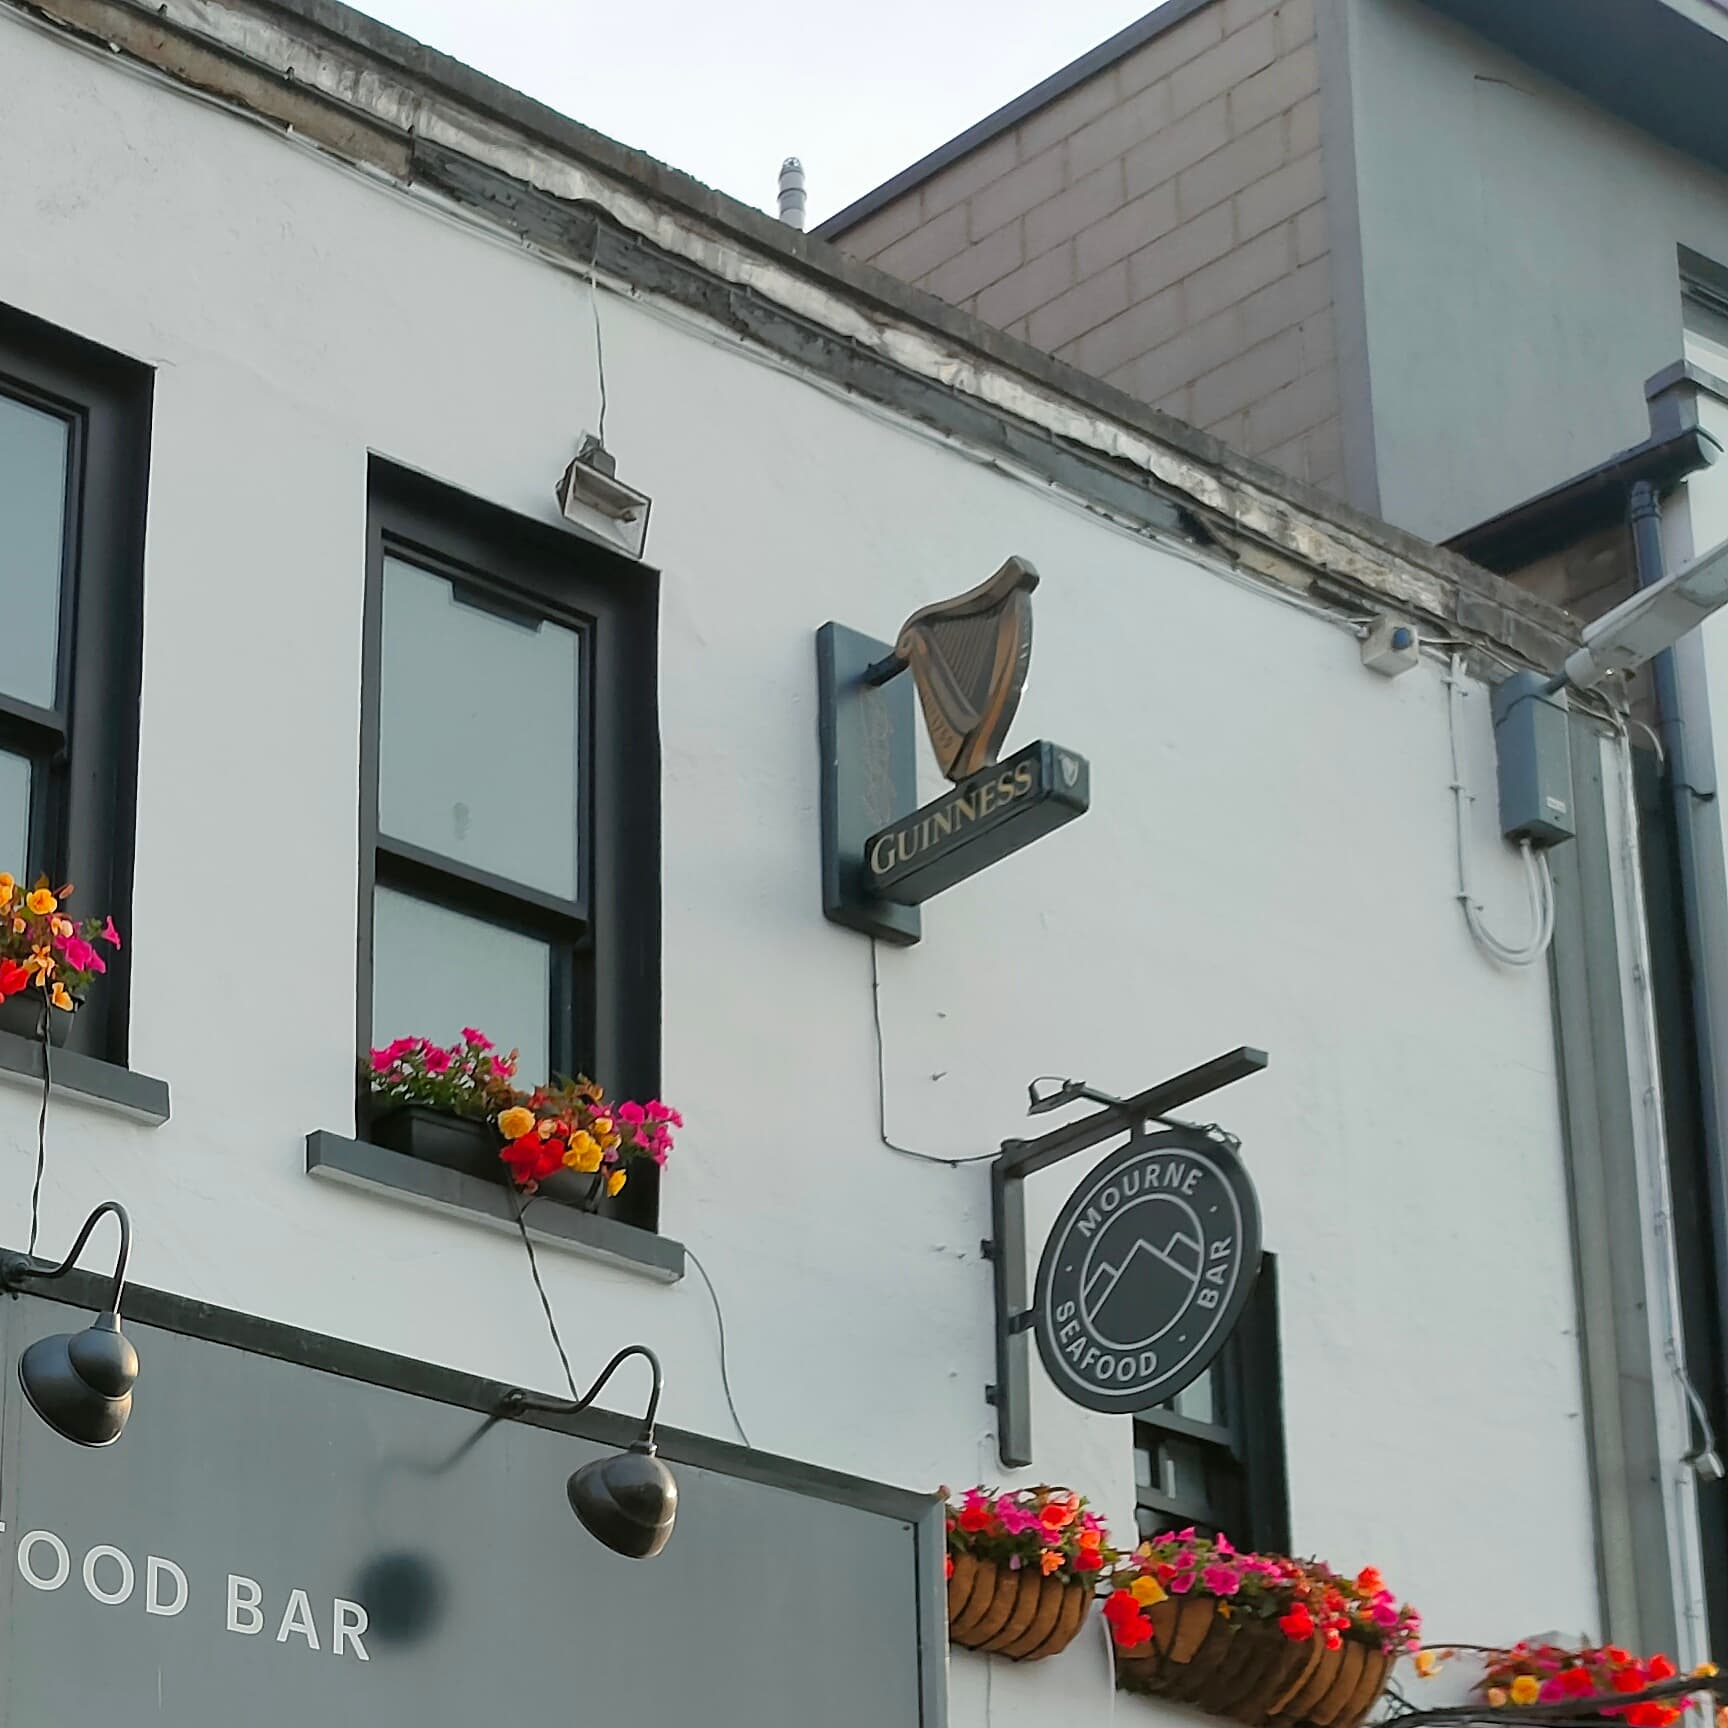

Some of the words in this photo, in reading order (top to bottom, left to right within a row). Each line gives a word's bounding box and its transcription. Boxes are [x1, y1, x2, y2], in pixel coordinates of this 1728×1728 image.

[870, 760, 1033, 875] GUINNESS
[1077, 1162, 1203, 1237] MOURNE
[1196, 1236, 1231, 1309] BAR
[1056, 1301, 1157, 1381] SEAFOOD
[226, 1573, 370, 1661] BAR
